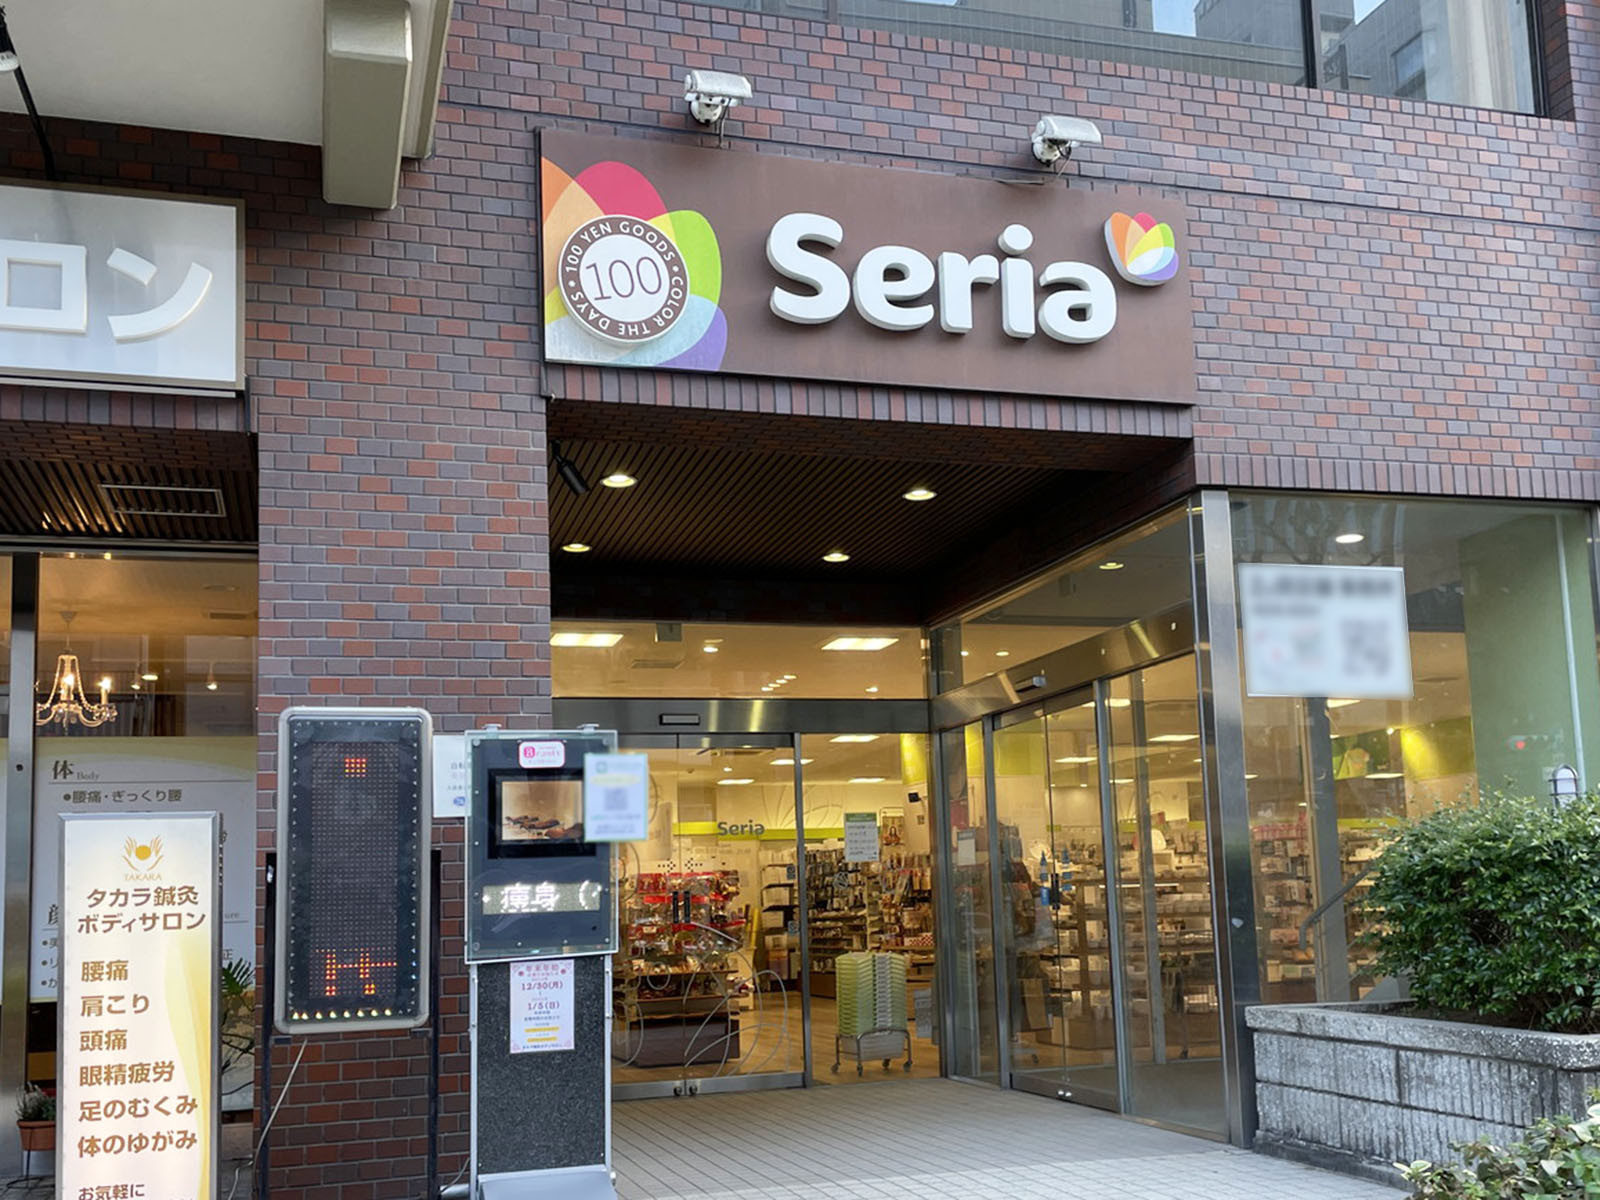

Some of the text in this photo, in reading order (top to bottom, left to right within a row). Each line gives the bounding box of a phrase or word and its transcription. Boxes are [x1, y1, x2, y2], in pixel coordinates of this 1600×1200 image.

[565, 221, 676, 273] 100 YEN GOODS
[585, 256, 662, 301] 100
[766, 212, 1118, 344] Seria
[0, 238, 213, 345] ロン
[570, 276, 685, 337] COLOR THE DAYS
[52, 760, 75, 780] 体
[77, 771, 99, 781] Body
[717, 819, 765, 836] Seria
[87, 885, 199, 908] タカラ鍼灸
[77, 912, 206, 934] ボディサロン
[80, 959, 129, 982] 腰痛
[80, 993, 150, 1017] 肩こり
[79, 1028, 128, 1052] 頭痛
[79, 1060, 175, 1087] 眼精疲労
[78, 1095, 198, 1122] 足のむくみ
[77, 1129, 198, 1159] 体のゆがみ
[78, 1184, 145, 1200] お気軽に
